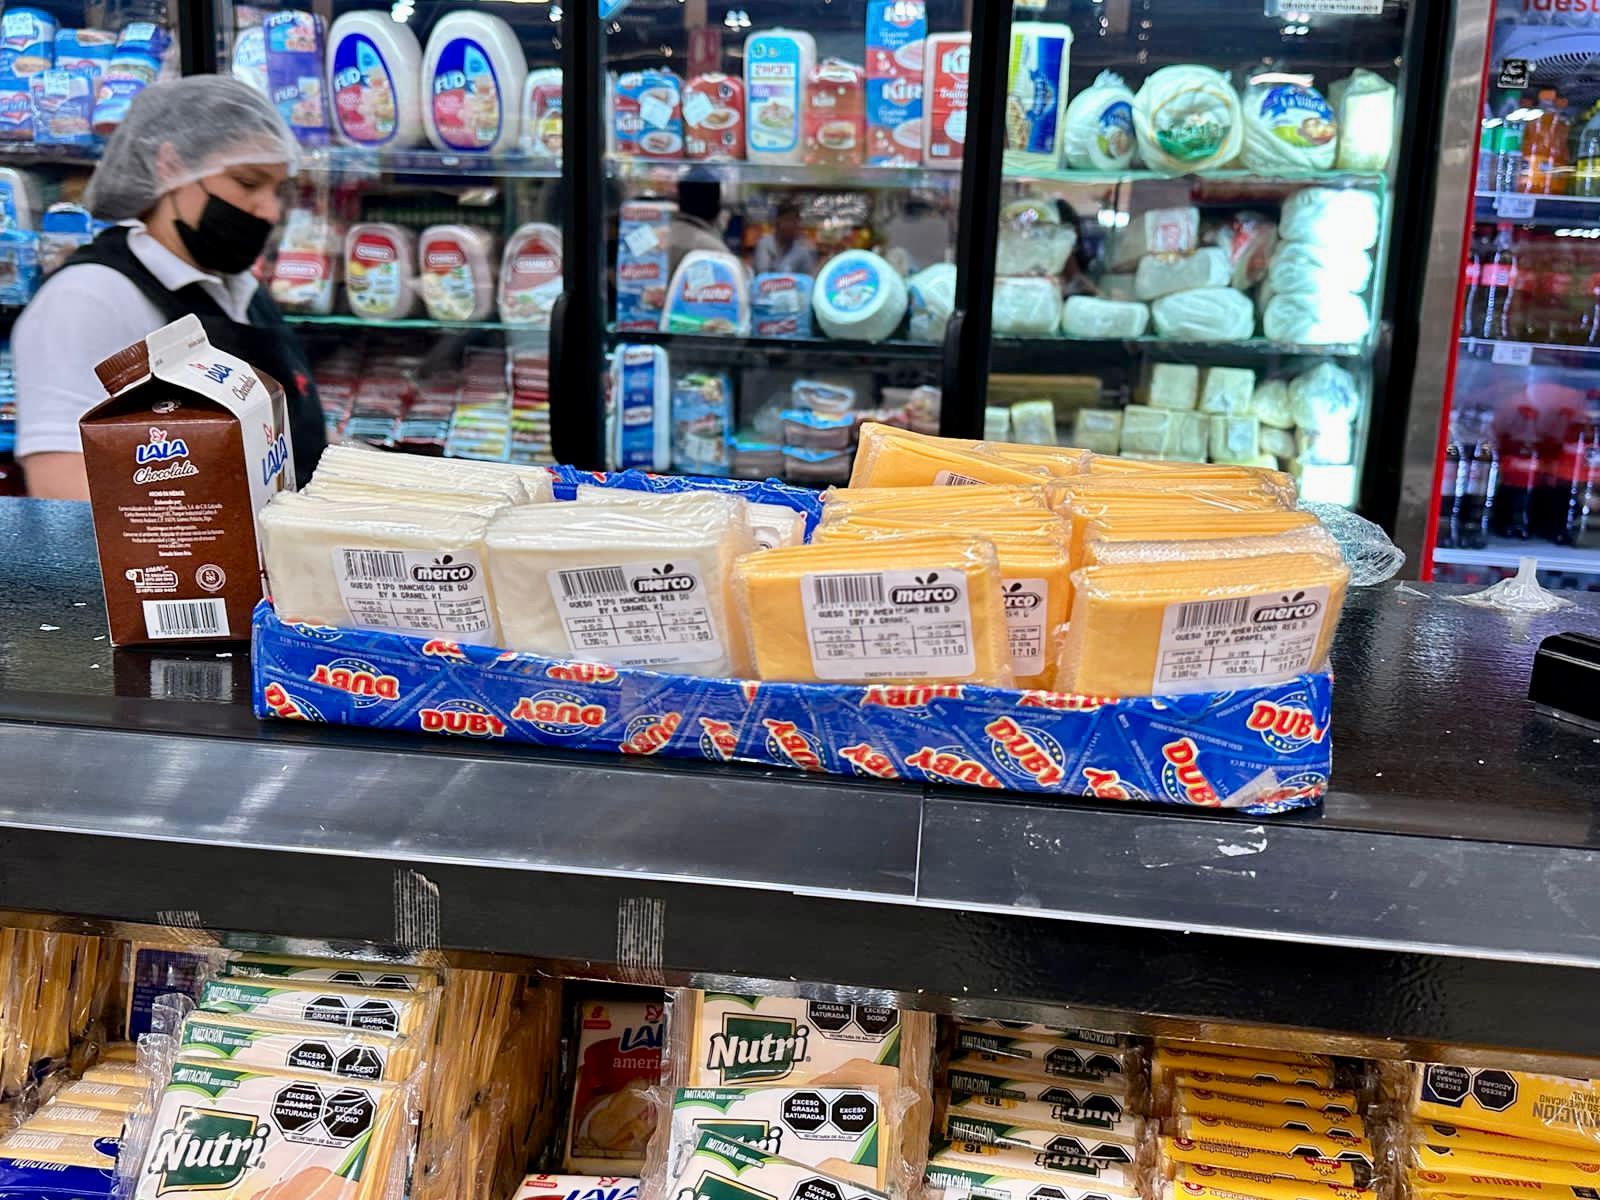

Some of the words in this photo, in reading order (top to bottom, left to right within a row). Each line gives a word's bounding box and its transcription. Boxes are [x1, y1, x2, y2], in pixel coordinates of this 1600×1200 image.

[335, 68, 361, 91] FUD
[434, 72, 465, 94] FUD
[205, 363, 234, 385] LALA
[137, 440, 188, 463] LALA
[262, 434, 288, 486] LALA
[134, 461, 199, 484] Chocolala
[417, 567, 470, 581] merco
[350, 582, 373, 590] QUESO
[377, 583, 395, 591] TIPO
[398, 583, 435, 592] MANCHEGO
[638, 577, 690, 592] merco
[400, 592, 427, 600] GRANEL
[896, 587, 955, 604] merco
[569, 600, 593, 609] QUESO
[597, 599, 616, 607] TIPO
[620, 596, 657, 605] MANCHEGO
[622, 605, 649, 613] GRANEL
[818, 608, 843, 618] QUESO
[848, 608, 869, 617] TIPO
[1257, 604, 1316, 621] merco
[1175, 632, 1201, 642] QUESO
[1206, 629, 1226, 639] TIPO
[1230, 625, 1278, 637] AMERICANO
[308, 664, 401, 701] DUBY
[511, 696, 606, 728] DUBY
[418, 709, 508, 739] DUBY
[985, 716, 1065, 787] DUBY
[1162, 737, 1223, 808] DUB
[817, 1003, 844, 1013] GRASAS
[864, 1006, 890, 1015] EXCESO
[360, 1015, 388, 1025] EXCESO
[811, 1011, 850, 1021] SATURADAS
[866, 1014, 888, 1023] SODIO
[707, 1025, 809, 1070] Nutri
[298, 1049, 327, 1061] EXCESO
[1436, 1075, 1463, 1085] GRASAS
[1435, 1082, 1462, 1092] EXCESO
[1480, 1087, 1507, 1097] EXCESO
[286, 1091, 315, 1101] EXCESO
[792, 1098, 819, 1106] EXCESO
[983, 1096, 1002, 1107] 16
[284, 1101, 313, 1111] GRASAS
[334, 1105, 364, 1116] EXCESO
[791, 1105, 819, 1113] GRASAS
[840, 1106, 867, 1115] EXCESO
[275, 1108, 318, 1119] SATURADAS
[785, 1112, 825, 1121] SATURADAS
[842, 1113, 864, 1122] SODIO
[1051, 1104, 1122, 1123] Nutri
[335, 1115, 358, 1125] SODIO
[5, 1134, 66, 1151] IMITACIÓN
[149, 1123, 271, 1173] Nutri
[963, 1143, 982, 1154] 16
[1034, 1152, 1109, 1170] Nutri
[1471, 1174, 1542, 1190] AMARILLO
[807, 1184, 836, 1199] EXCESO
